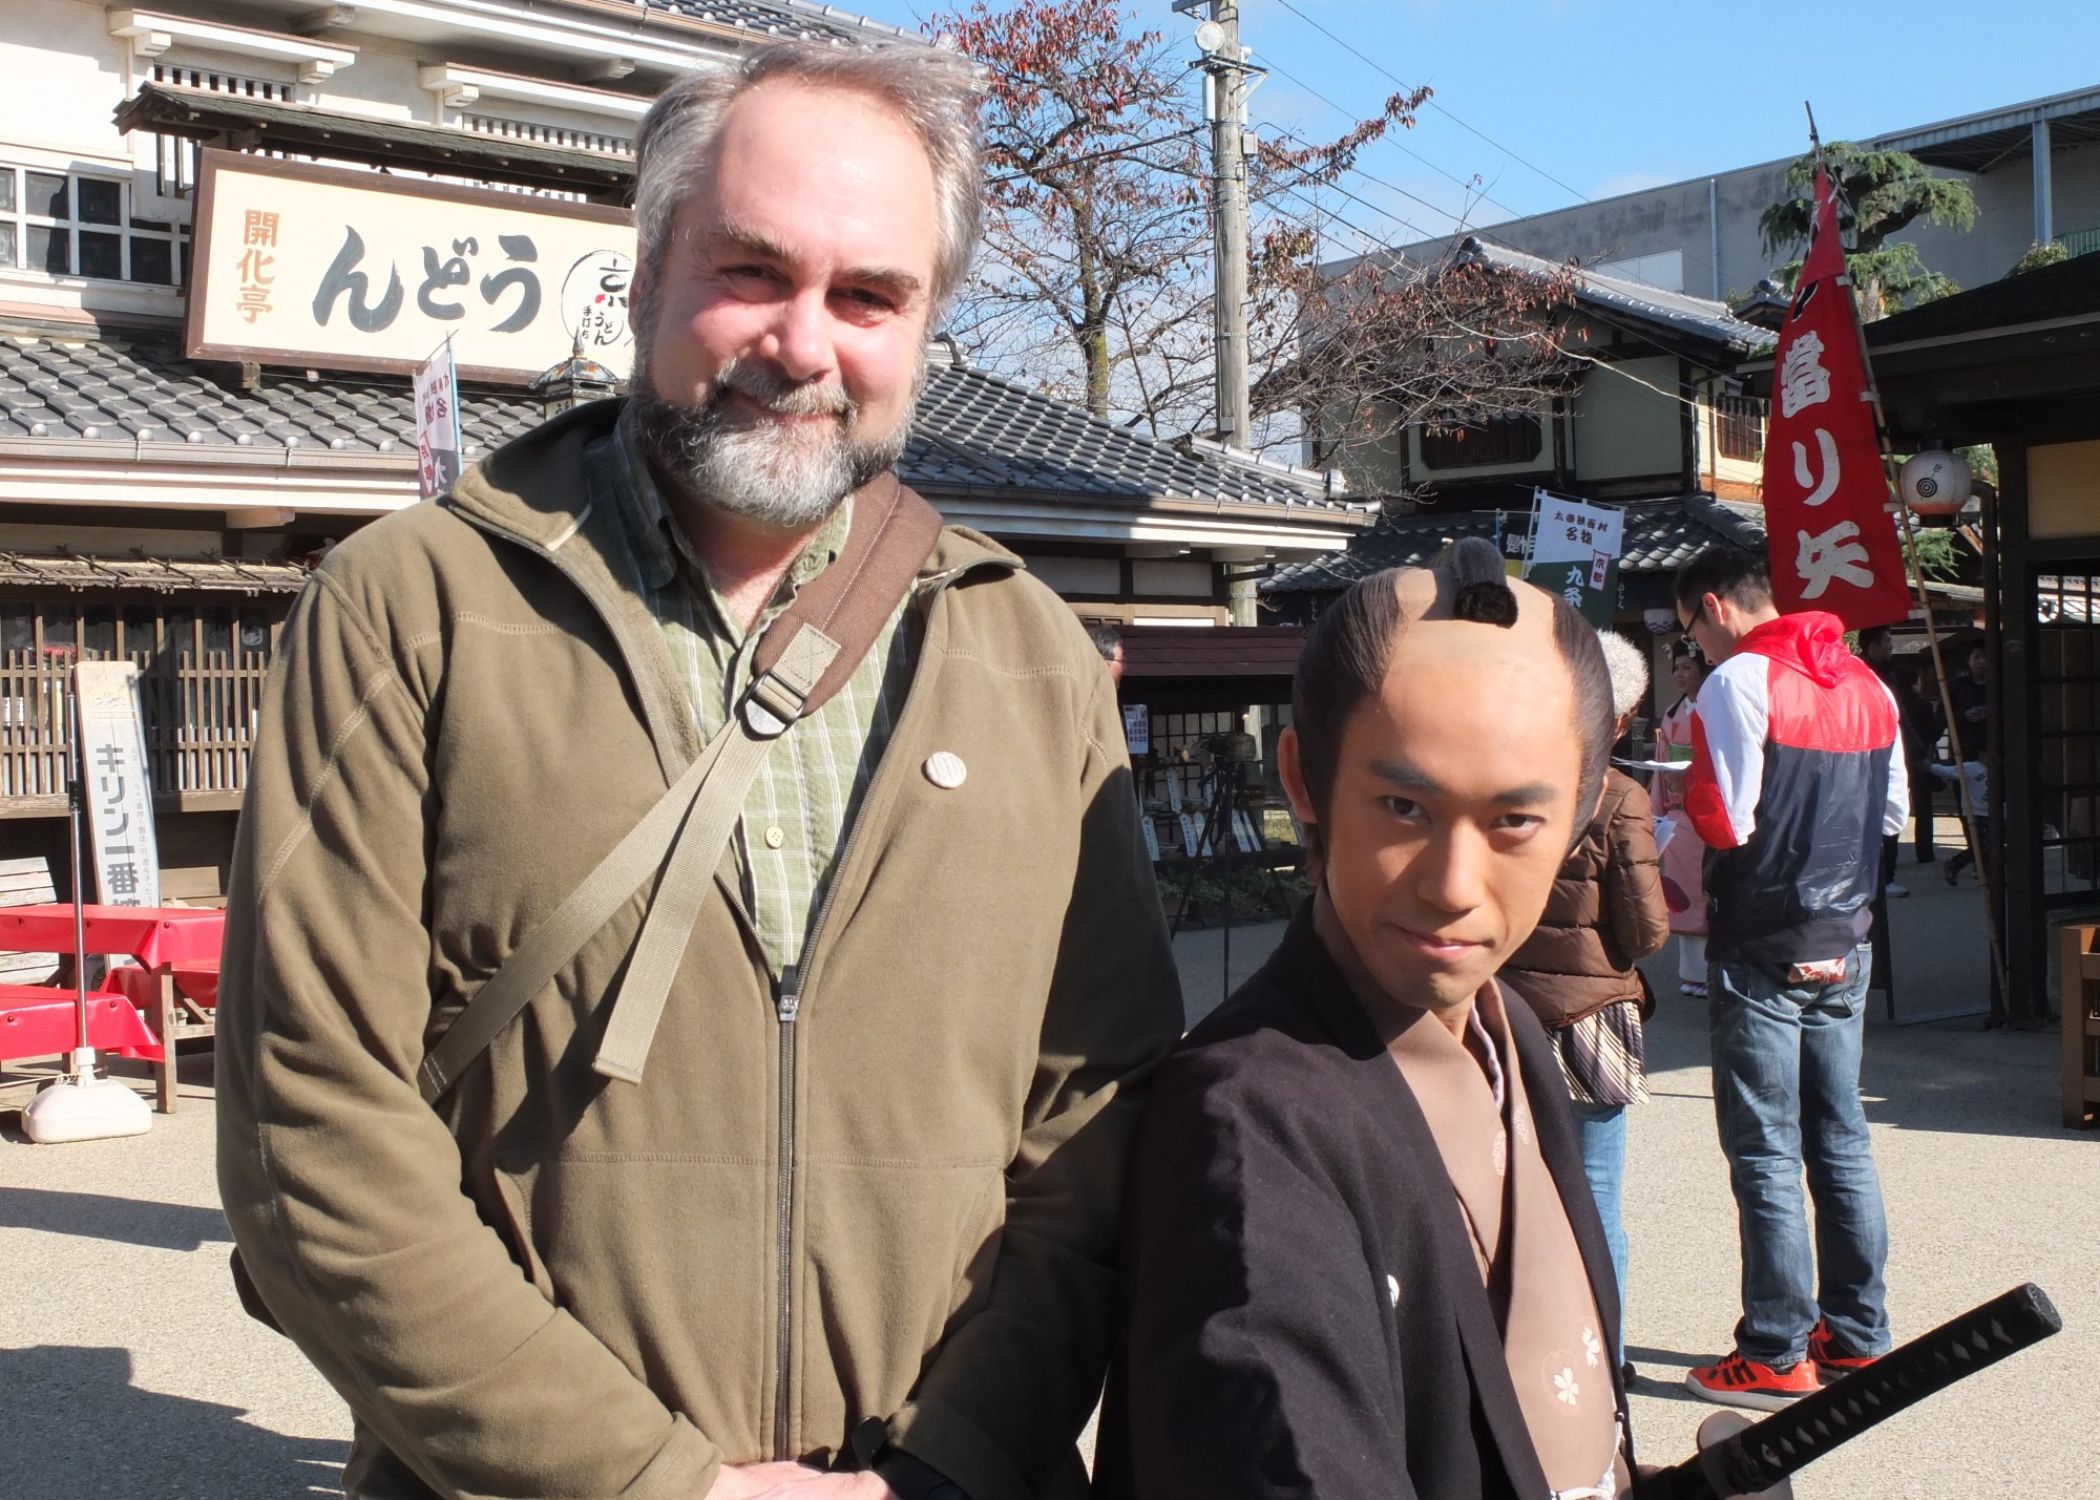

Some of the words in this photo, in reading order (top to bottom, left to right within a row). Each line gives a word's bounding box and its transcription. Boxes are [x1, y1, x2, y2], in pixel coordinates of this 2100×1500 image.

[236, 209, 279, 324] 開化亭
[96, 744, 140, 905] キリン一番
